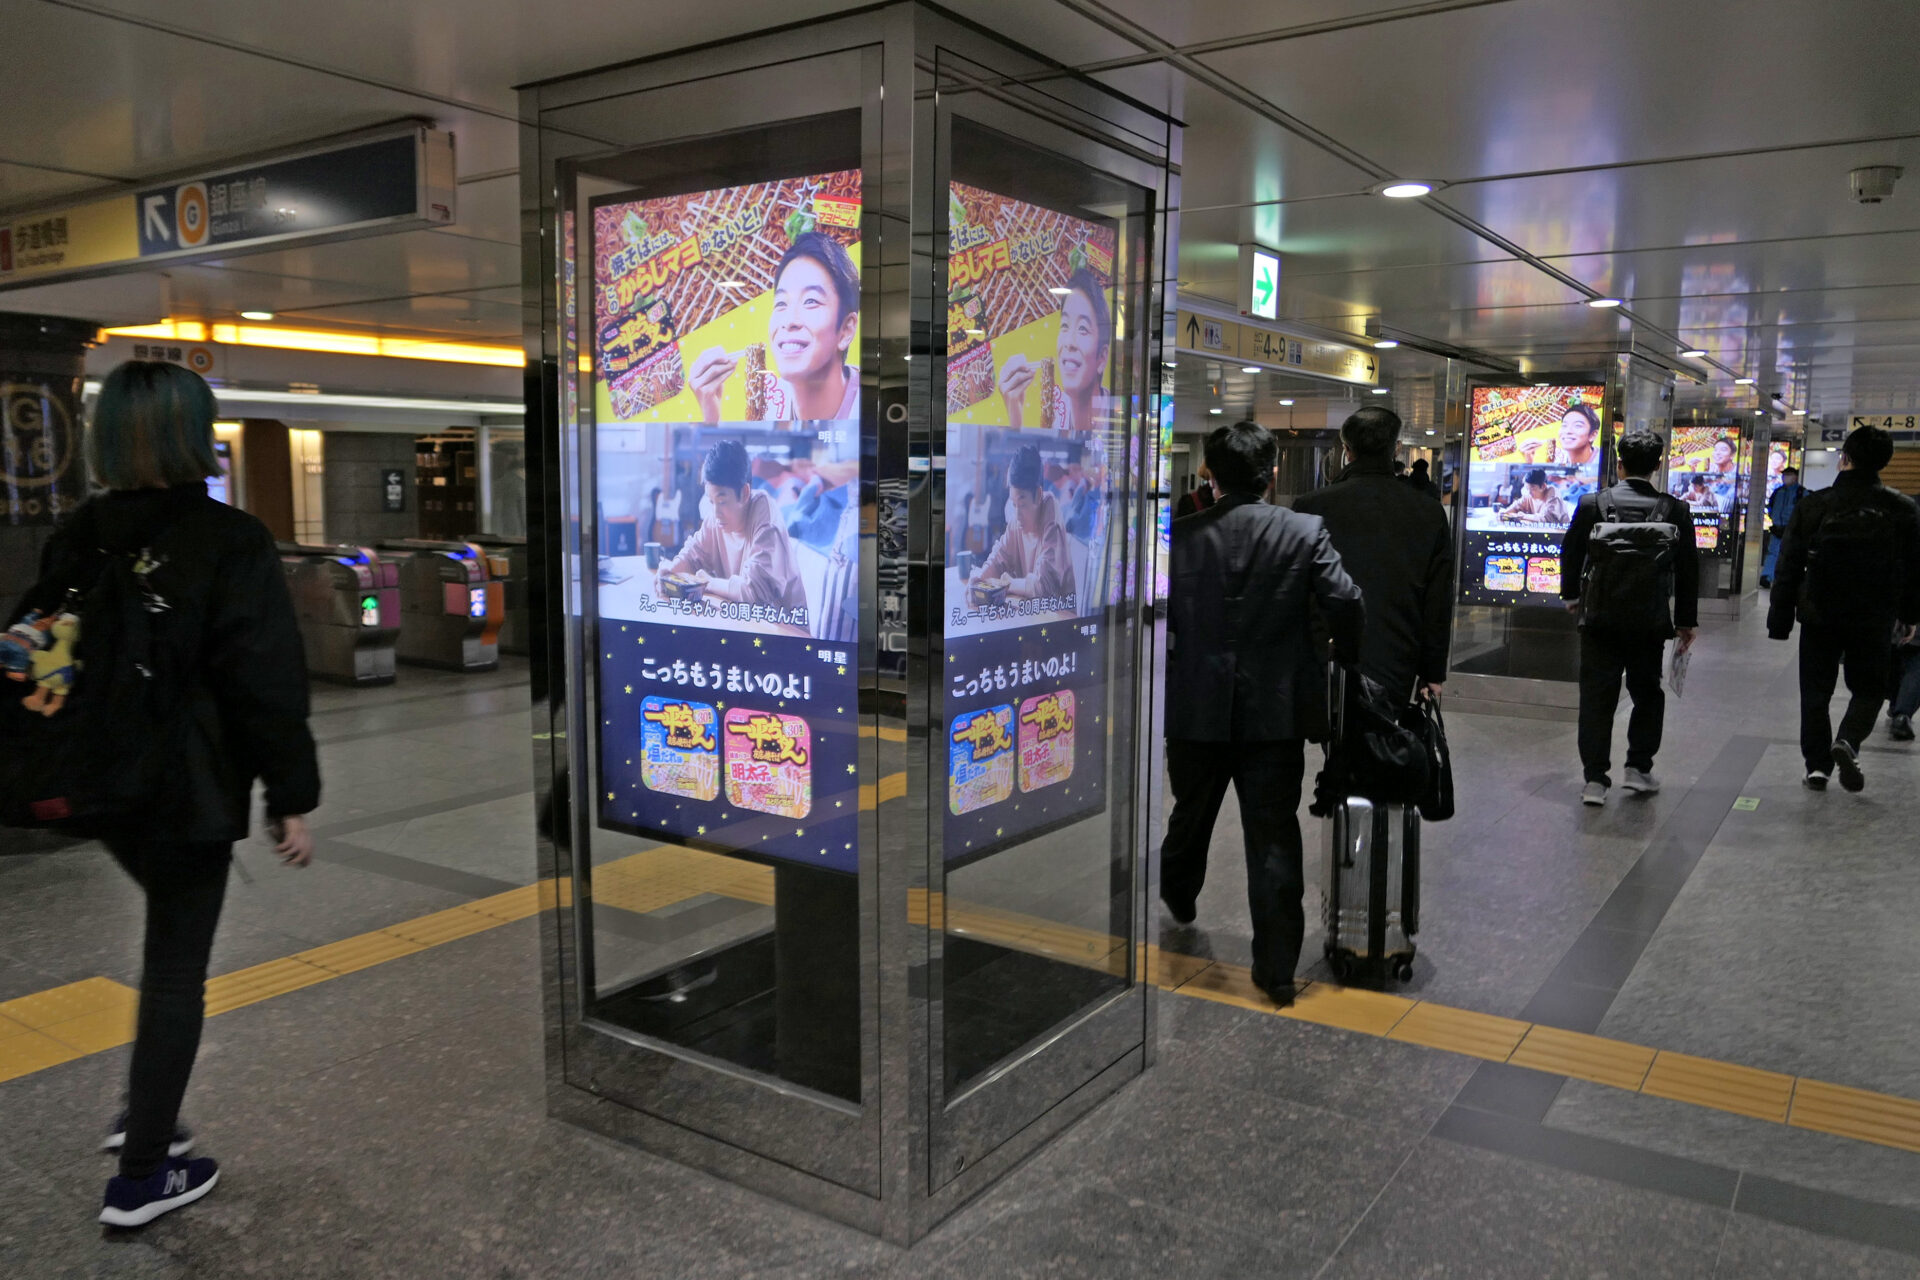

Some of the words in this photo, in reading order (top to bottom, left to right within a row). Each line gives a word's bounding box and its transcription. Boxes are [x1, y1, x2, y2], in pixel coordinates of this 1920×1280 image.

[609, 229, 676, 279] 焼そばには、
[618, 234, 703, 308] からしマヨ
[639, 594, 716, 617] え。一平ちゃん
[720, 602, 809, 626] 30周年なんだ!
[951, 604, 1016, 626] え。一平ちゃん
[1018, 594, 1076, 616] 30周年なんだ!
[818, 650, 847, 664] 明星
[952, 652, 1077, 698] こっちもうまいのよ!
[642, 657, 811, 700] こっちもうまいのよ!
[162, 1169, 187, 1195] N
